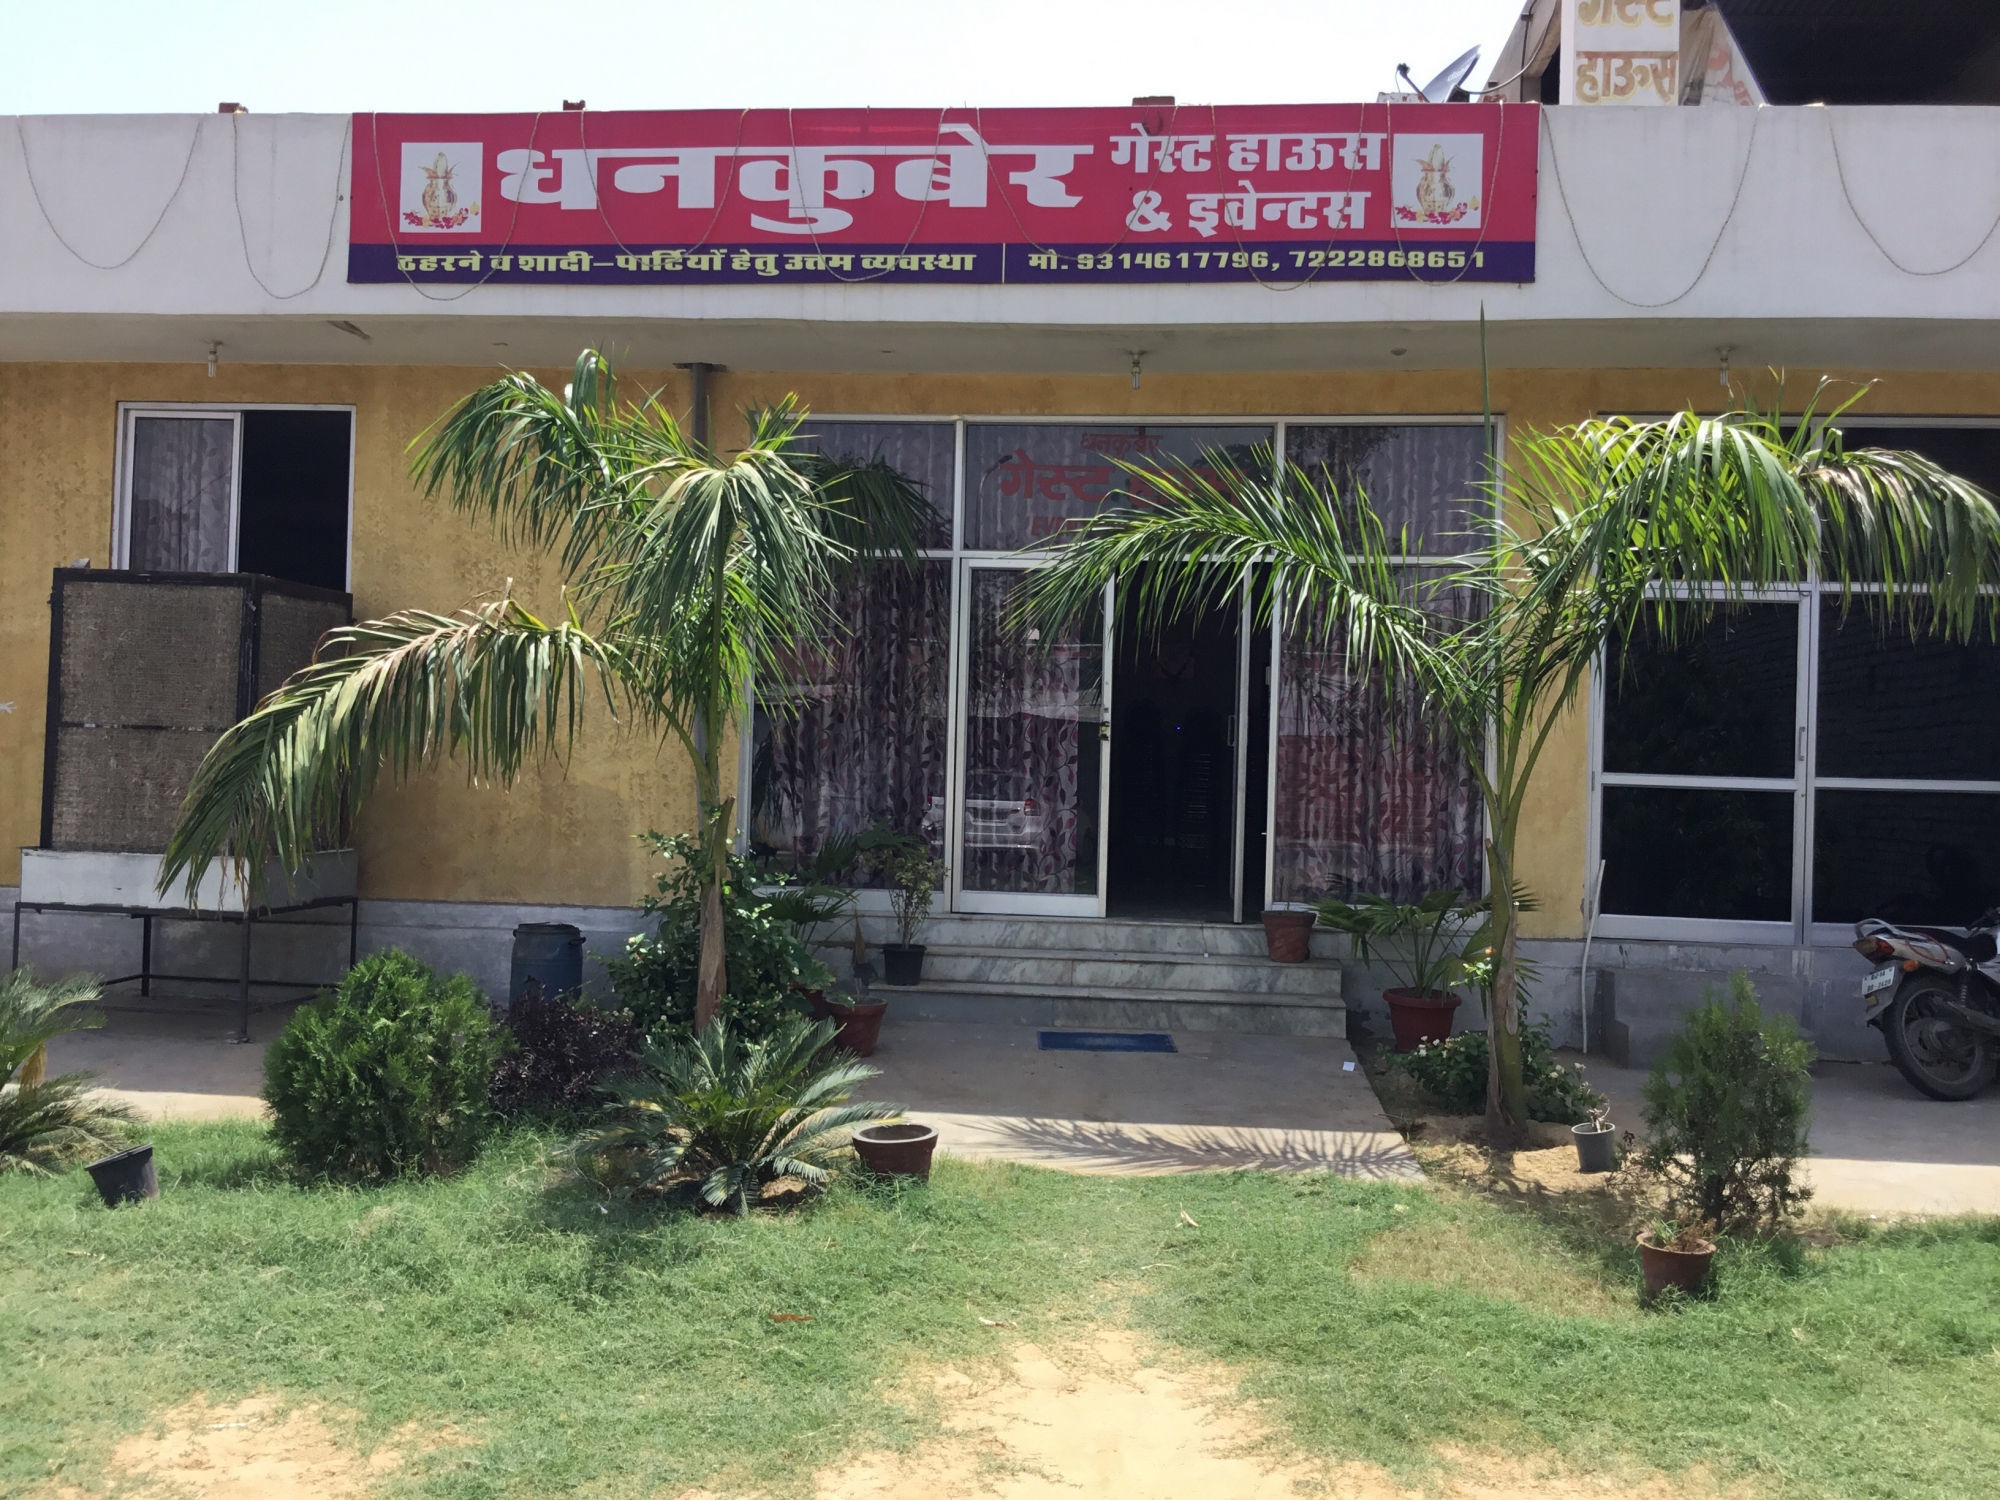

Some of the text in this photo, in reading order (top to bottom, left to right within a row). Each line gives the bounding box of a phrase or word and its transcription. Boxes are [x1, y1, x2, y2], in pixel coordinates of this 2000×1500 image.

[1109, 123, 1387, 174] गेस्ट हाऊस
[496, 123, 1094, 234] धनकुबेर
[1126, 189, 1171, 232] &
[396, 250, 484, 272] ठहरने
[489, 254, 513, 272] व
[730, 249, 780, 276] हेतु
[783, 253, 855, 272] उत्तम
[860, 253, 977, 272] व्यवस्था
[1288, 250, 1485, 270] 7222868651
[1000, 448, 1116, 502] गेस्ट
